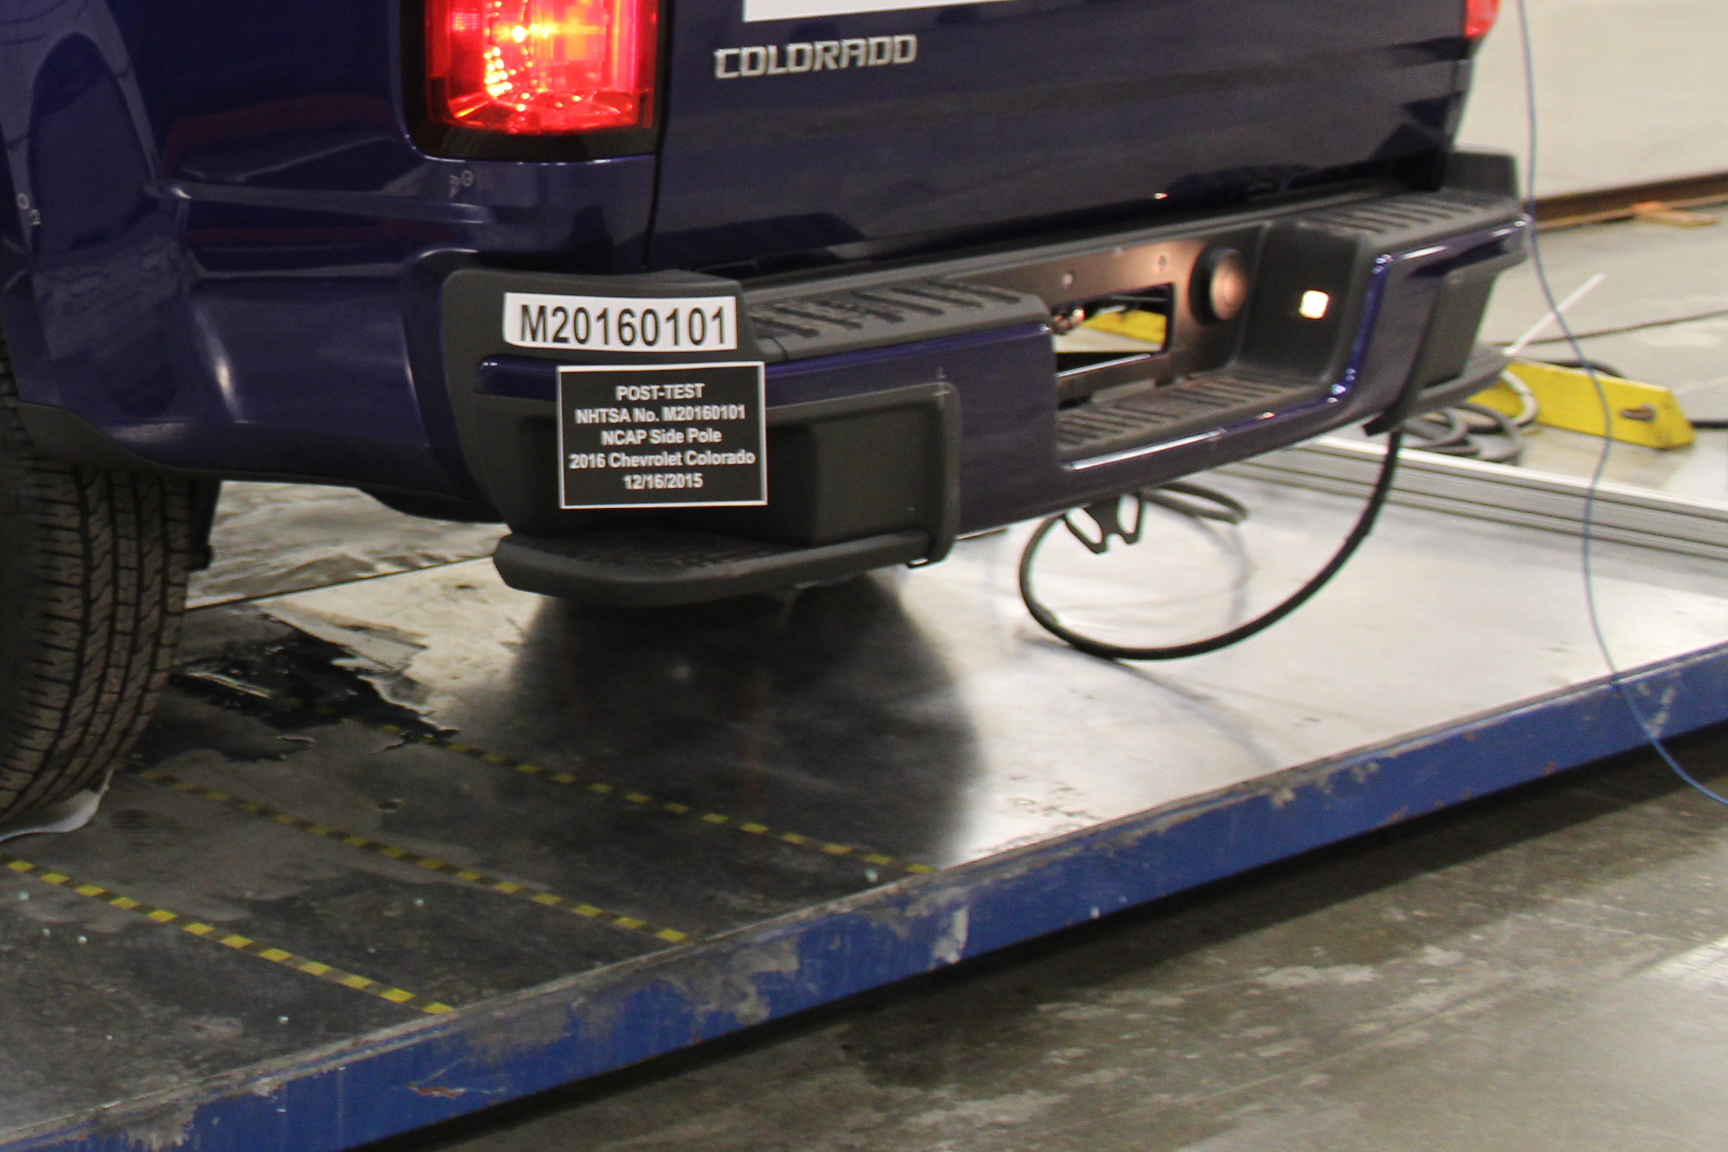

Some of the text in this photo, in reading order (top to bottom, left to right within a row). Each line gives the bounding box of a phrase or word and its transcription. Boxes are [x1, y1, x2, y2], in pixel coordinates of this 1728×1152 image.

[713, 34, 919, 79] COLORADO
[520, 304, 727, 347] M20160101
[615, 382, 705, 401] POST-TEST
[575, 404, 746, 424] NHTSA No. M20160101
[601, 427, 723, 446] NCAP Side Pole
[569, 448, 756, 470] 2016 Chevrolet Colorado
[623, 472, 704, 490] 12/16/2015
